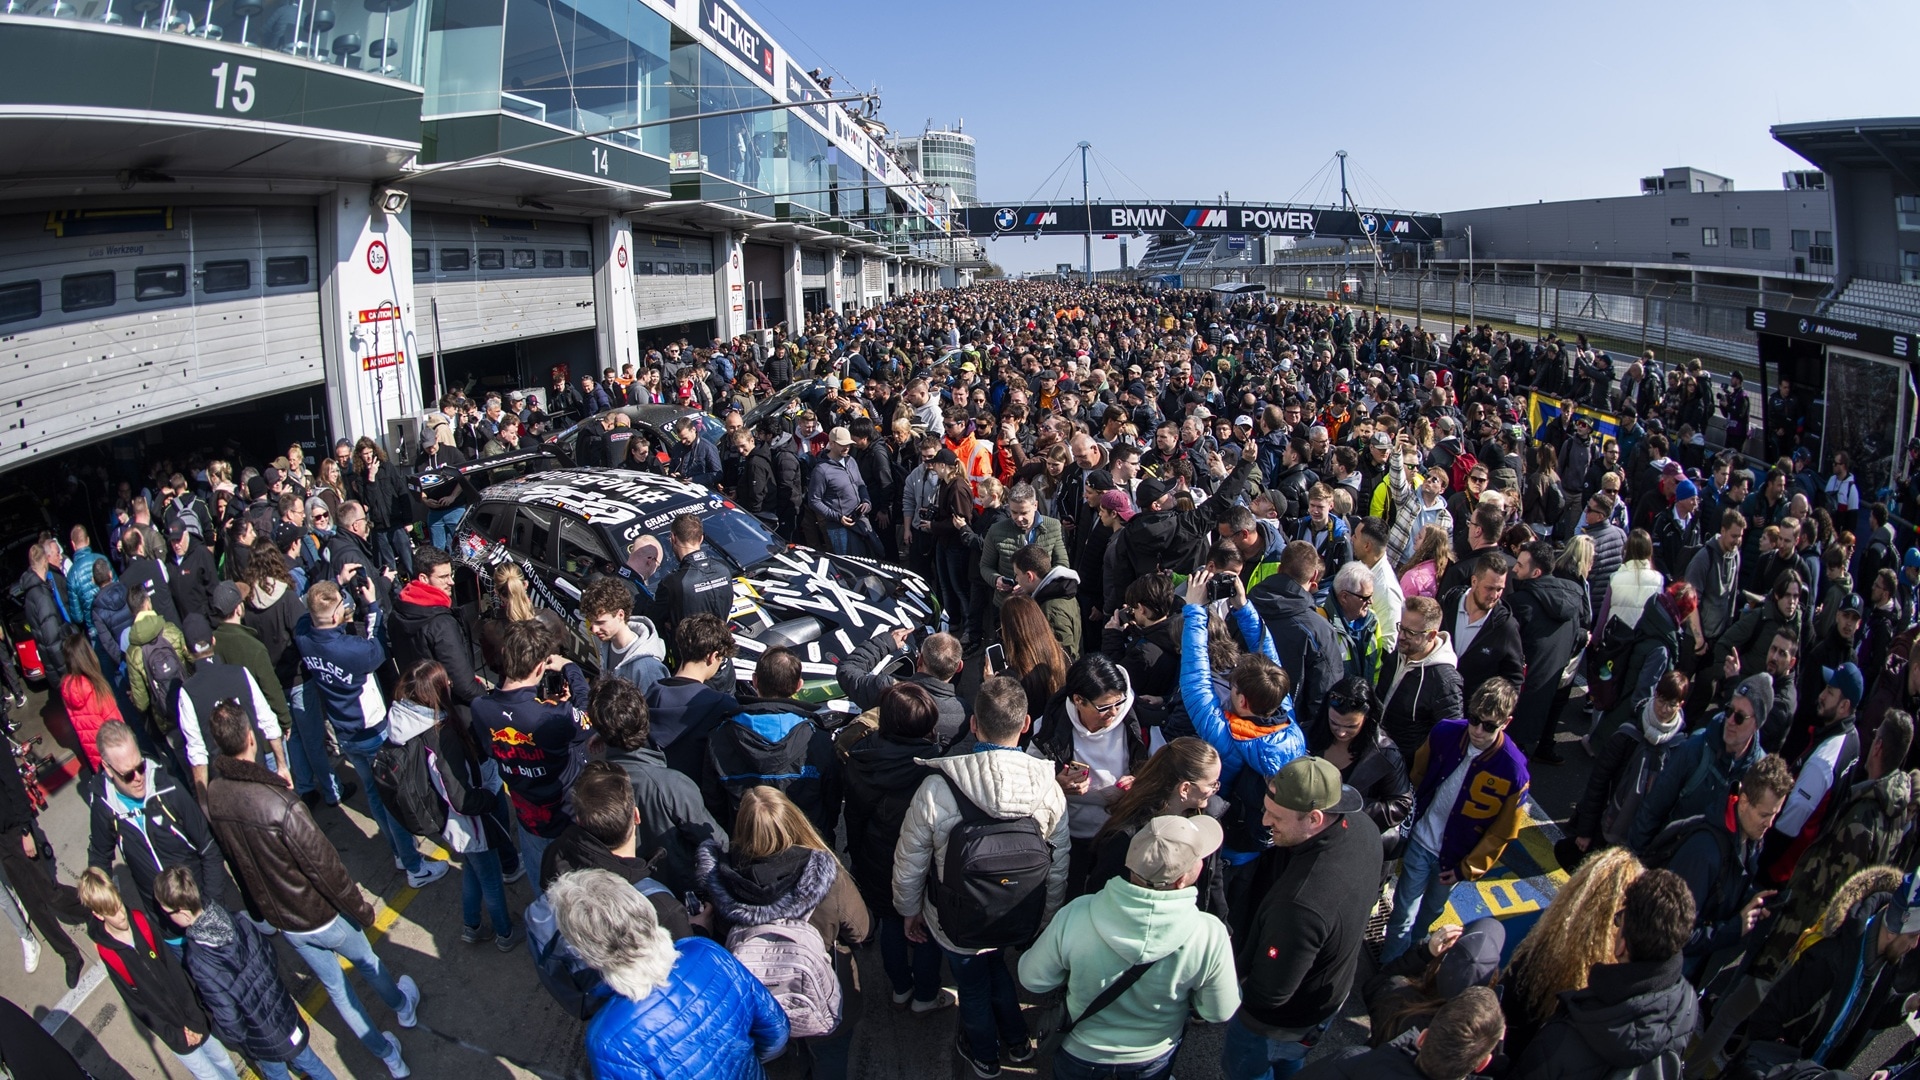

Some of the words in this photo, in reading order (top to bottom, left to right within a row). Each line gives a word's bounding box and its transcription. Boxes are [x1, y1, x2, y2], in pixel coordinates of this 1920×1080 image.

[709, 3, 759, 65] JOCKEL
[211, 62, 257, 113] 15
[591, 146, 609, 175] 14
[738, 189, 748, 209] 13
[1111, 208, 1166, 227] BMW
[1241, 210, 1314, 230] POWER
[105, 244, 144, 256] Werkzeug
[1824, 327, 1858, 341] Motorsport
[644, 512, 670, 528] GRAN
[522, 558, 535, 580] YOU
[533, 575, 567, 618] DREAMED
[566, 613, 577, 629] IT.
[303, 656, 353, 685] HELSEA
[320, 672, 334, 684] FC
[491, 745, 516, 759] Red
[518, 748, 545, 761] Bull
[502, 763, 533, 778] Mobil
[1460, 770, 1512, 820] S
